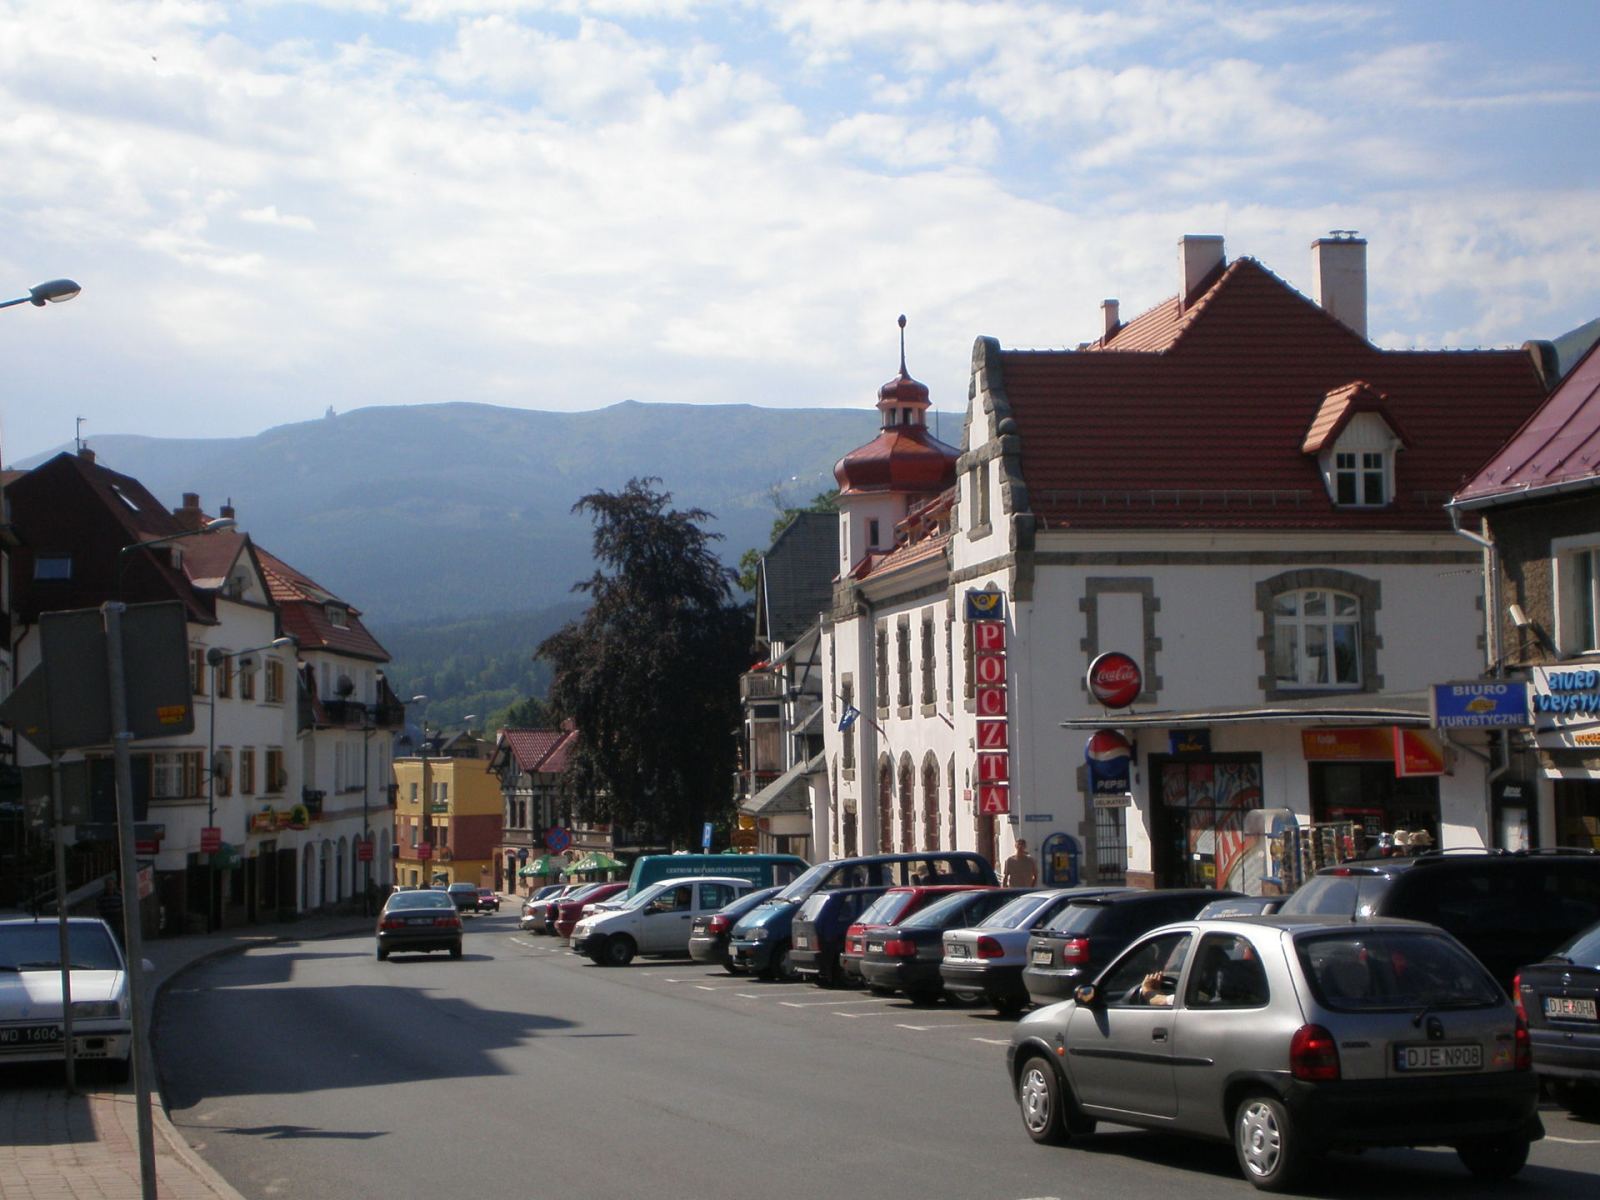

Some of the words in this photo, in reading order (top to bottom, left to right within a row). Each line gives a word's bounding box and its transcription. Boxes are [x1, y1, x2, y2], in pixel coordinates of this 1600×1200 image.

[1549, 670, 1597, 690] BIURO
[1452, 684, 1508, 696] BIURO
[980, 624, 1004, 812] POCZTA
[1439, 713, 1525, 727] TURYSTYCZNE
[1097, 779, 1127, 790] PEPSI
[1550, 998, 1569, 1014] DJE
[26, 1028, 57, 1041] 1606
[1408, 1048, 1441, 1067] DJE
[1445, 1047, 1479, 1065] N908
